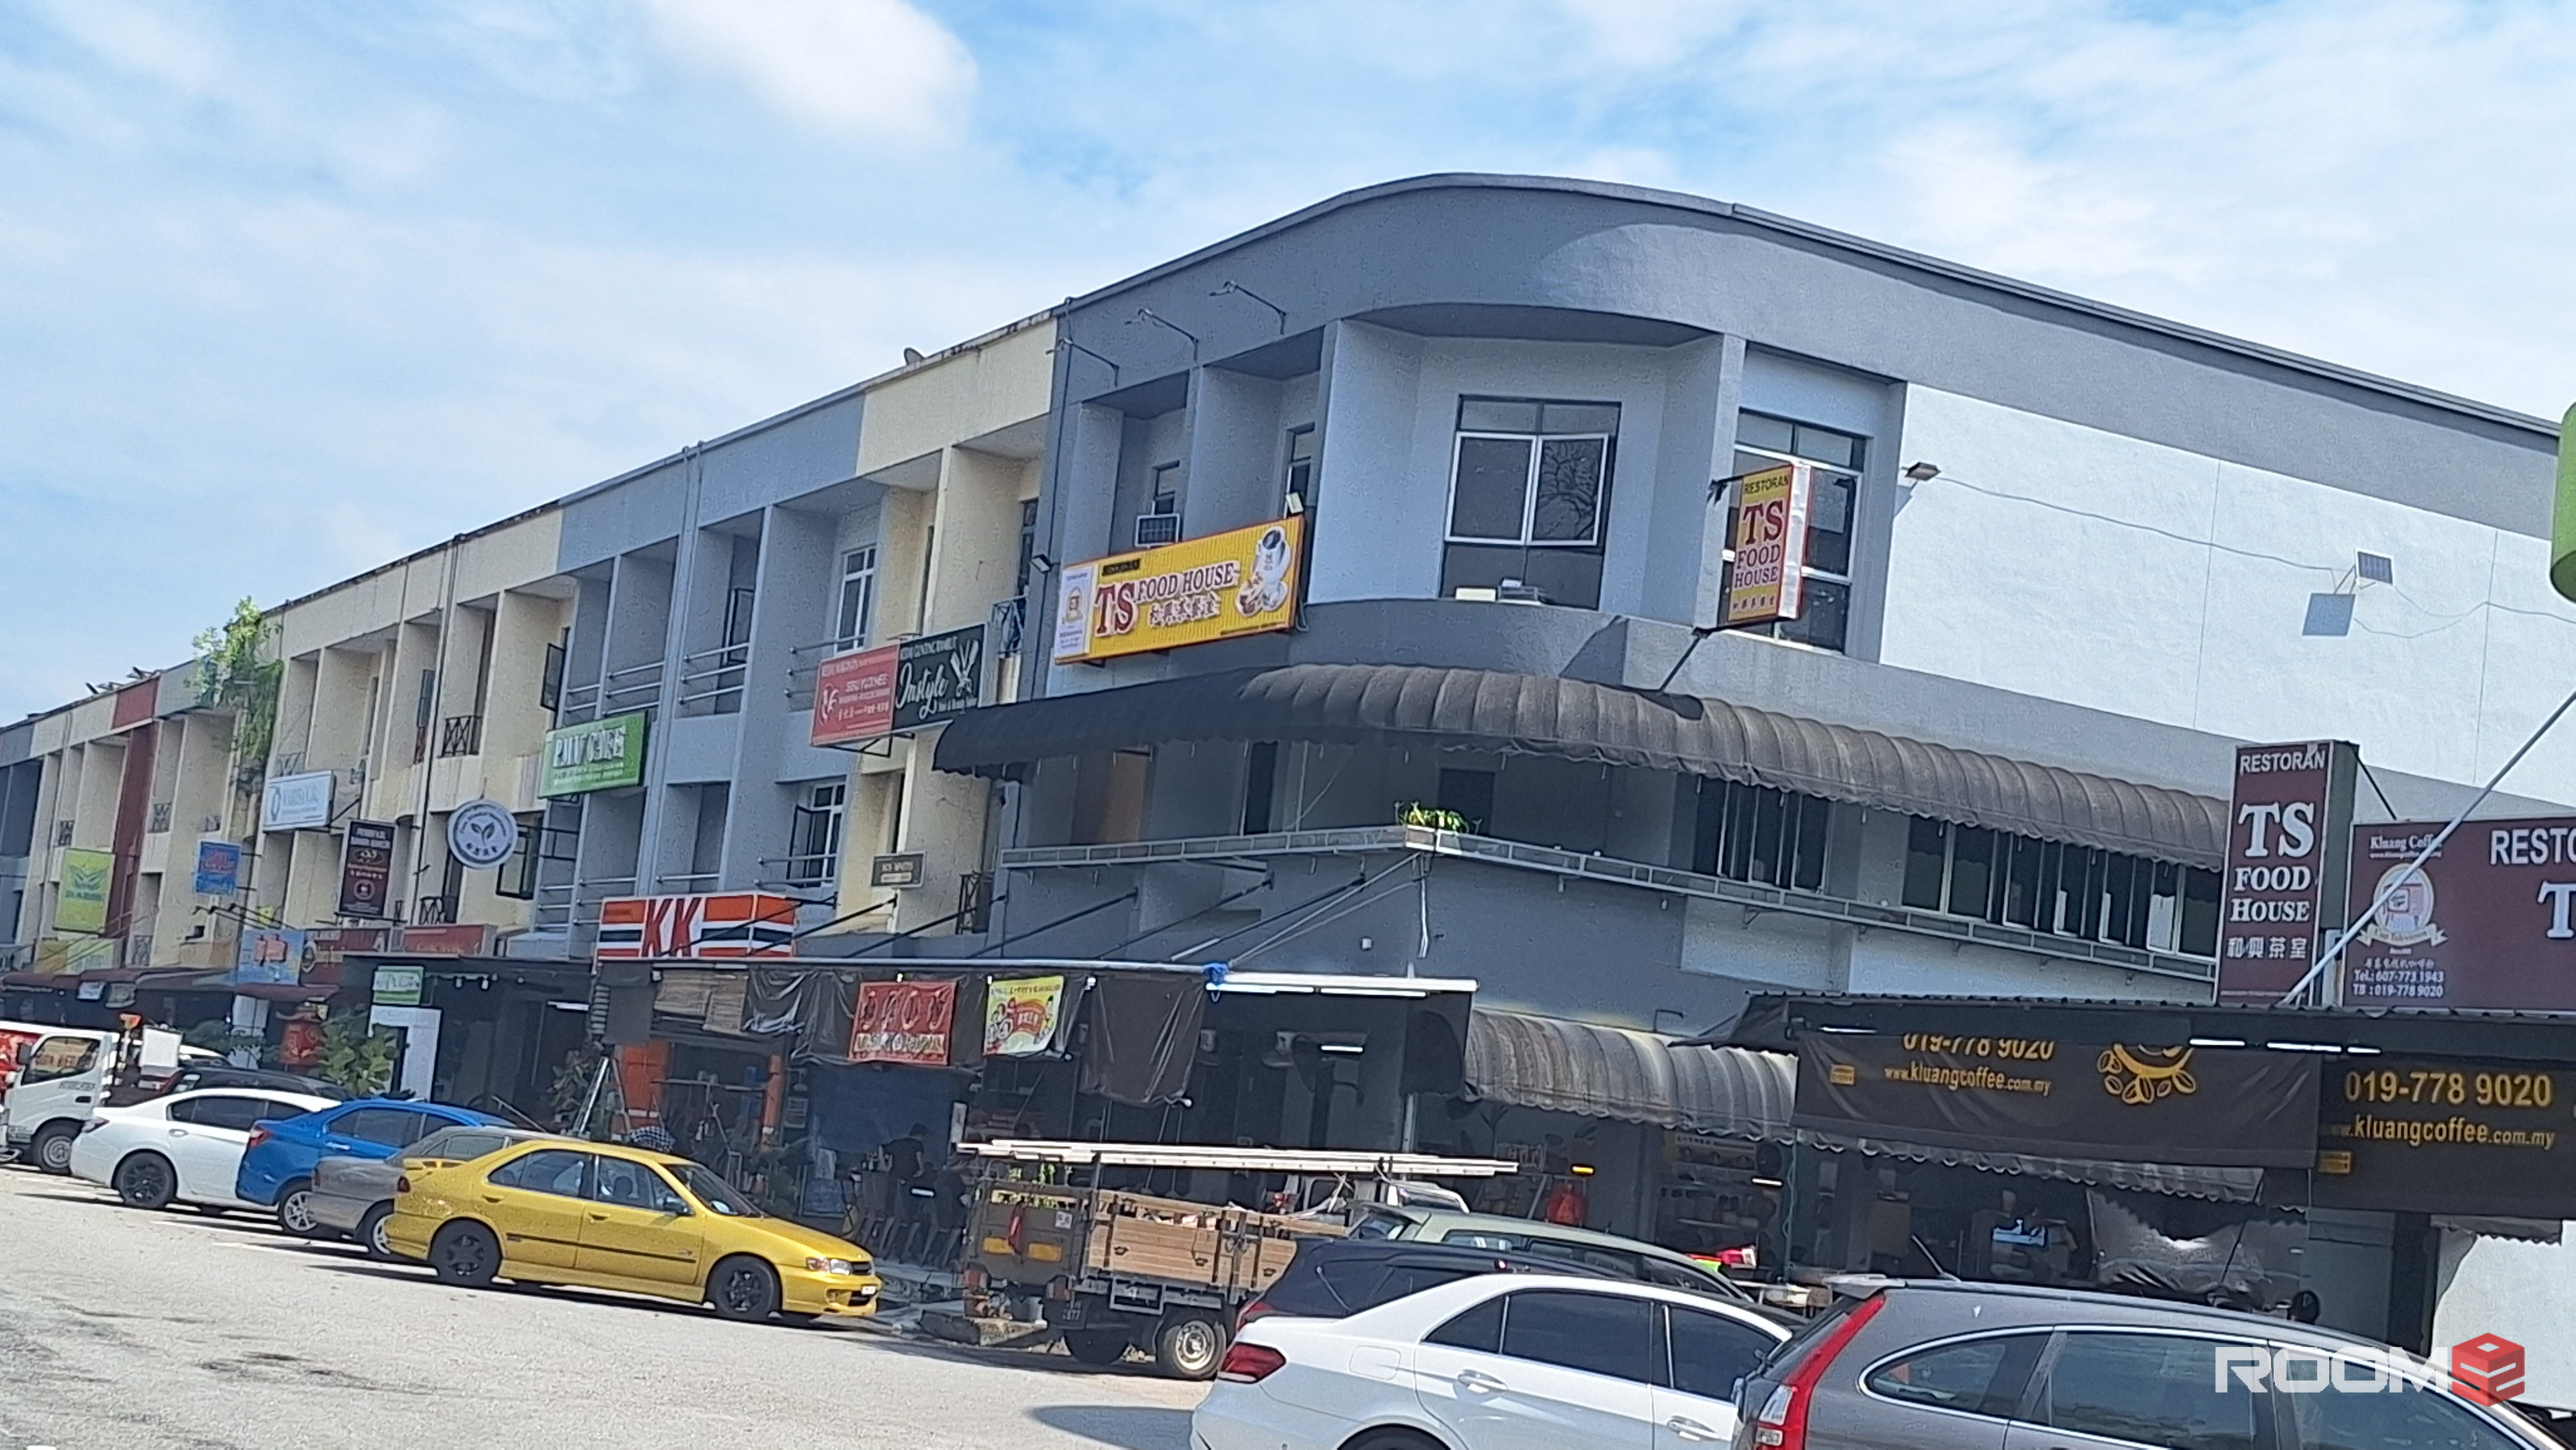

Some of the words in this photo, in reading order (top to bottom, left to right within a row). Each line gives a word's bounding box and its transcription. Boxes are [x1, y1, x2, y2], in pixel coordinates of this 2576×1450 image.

[1744, 474, 1789, 494] RESTORAN
[1743, 500, 1784, 545] TS
[1737, 544, 1780, 570] FOOD
[1734, 566, 1779, 588] HOUSE
[1095, 581, 1135, 634] TS
[1138, 575, 1178, 601] FOOD
[1183, 563, 1234, 594] HOUSE
[2239, 750, 2326, 775] RESTORAN
[2238, 801, 2315, 858] TS
[2234, 866, 2311, 891] FOOD
[2230, 899, 2311, 922] HOUSE
[641, 897, 703, 957] KK
[2345, 1070, 2466, 1105] 019-778
[2476, 1074, 2553, 1107] 9020
